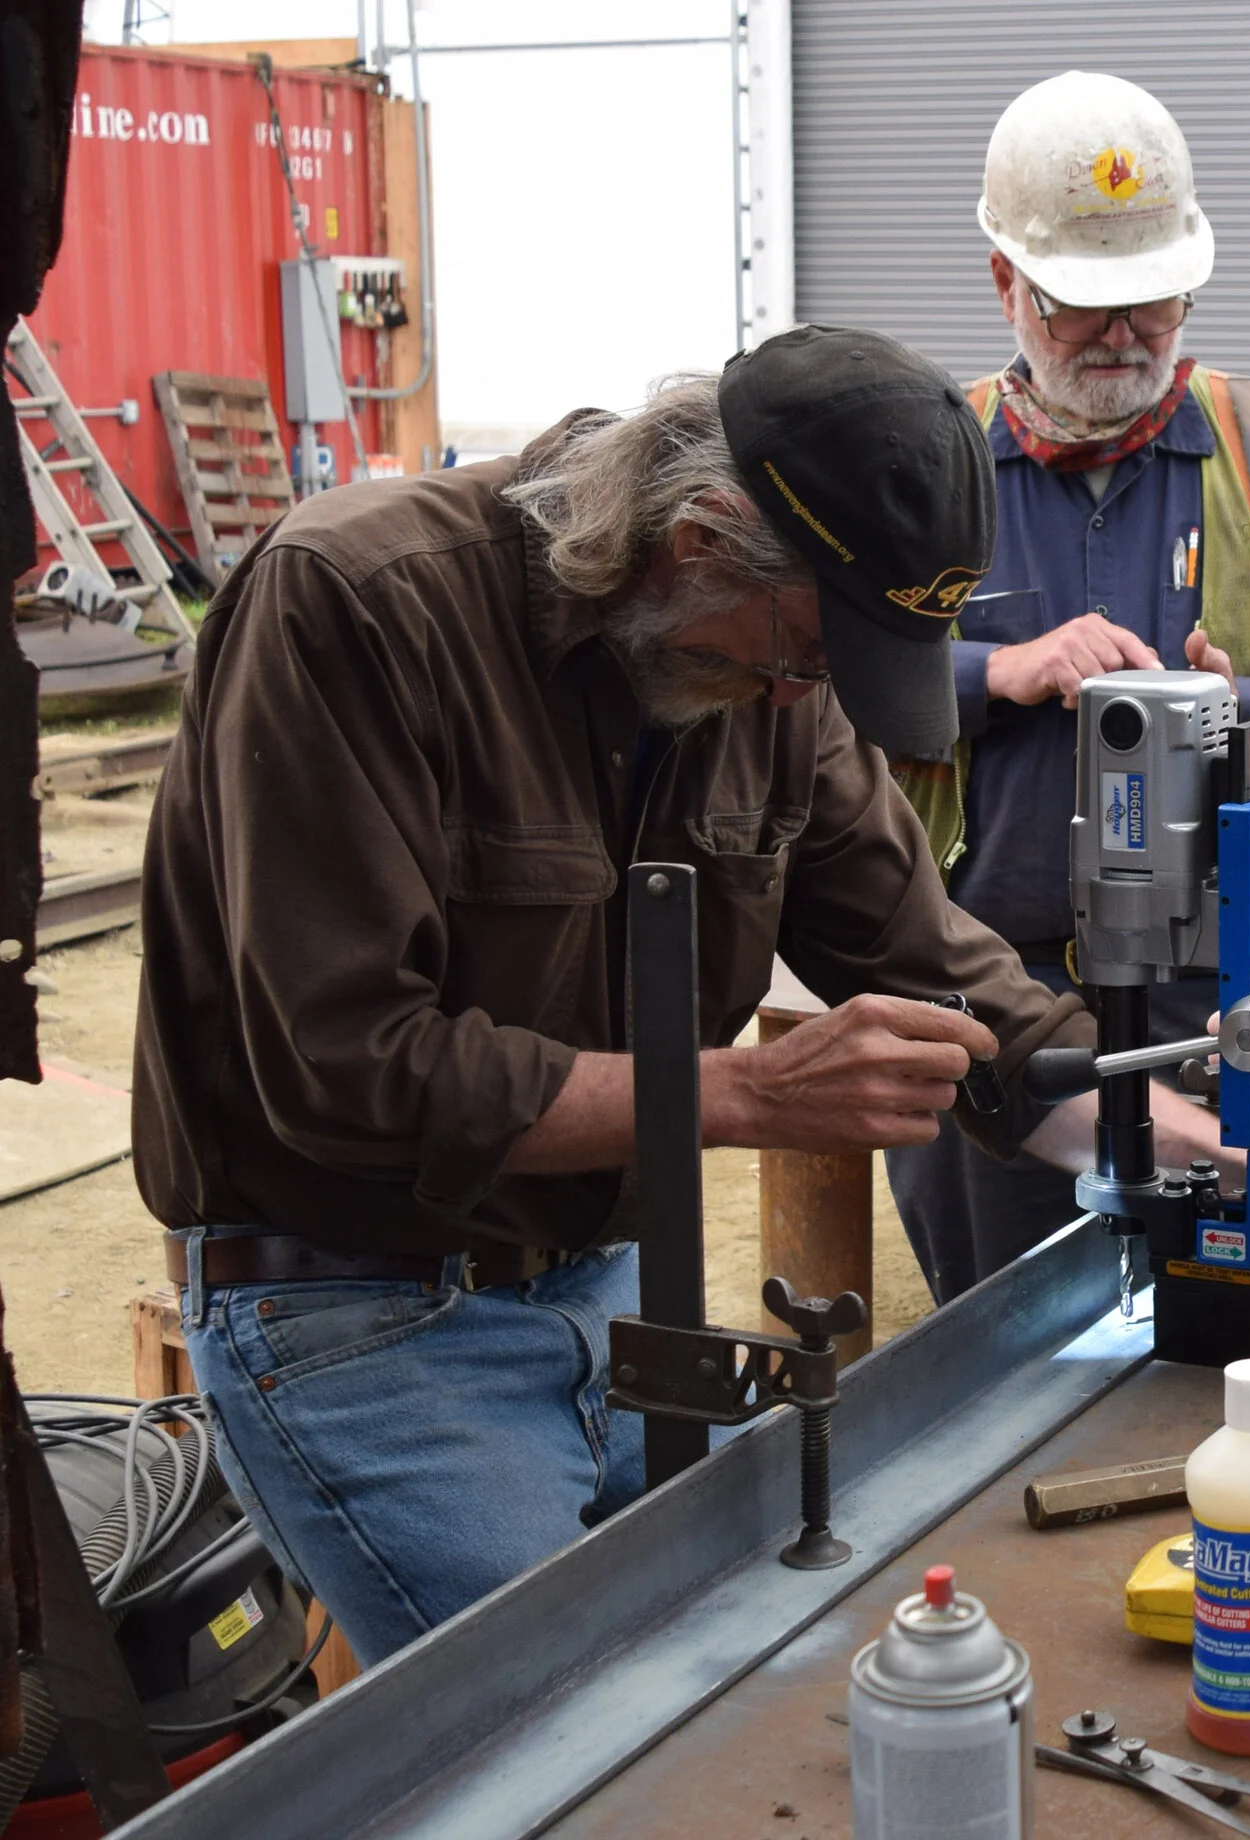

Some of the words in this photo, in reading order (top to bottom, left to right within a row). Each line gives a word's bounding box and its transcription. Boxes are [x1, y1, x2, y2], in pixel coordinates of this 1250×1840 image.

[1130, 780, 1142, 843] HMD904
[1216, 1235, 1243, 1245] UNLOCK
[1205, 1245, 1231, 1256] LOCK
[1221, 1608, 1250, 1619] CUTTING
[1216, 1617, 1247, 1629] CUTTERS
